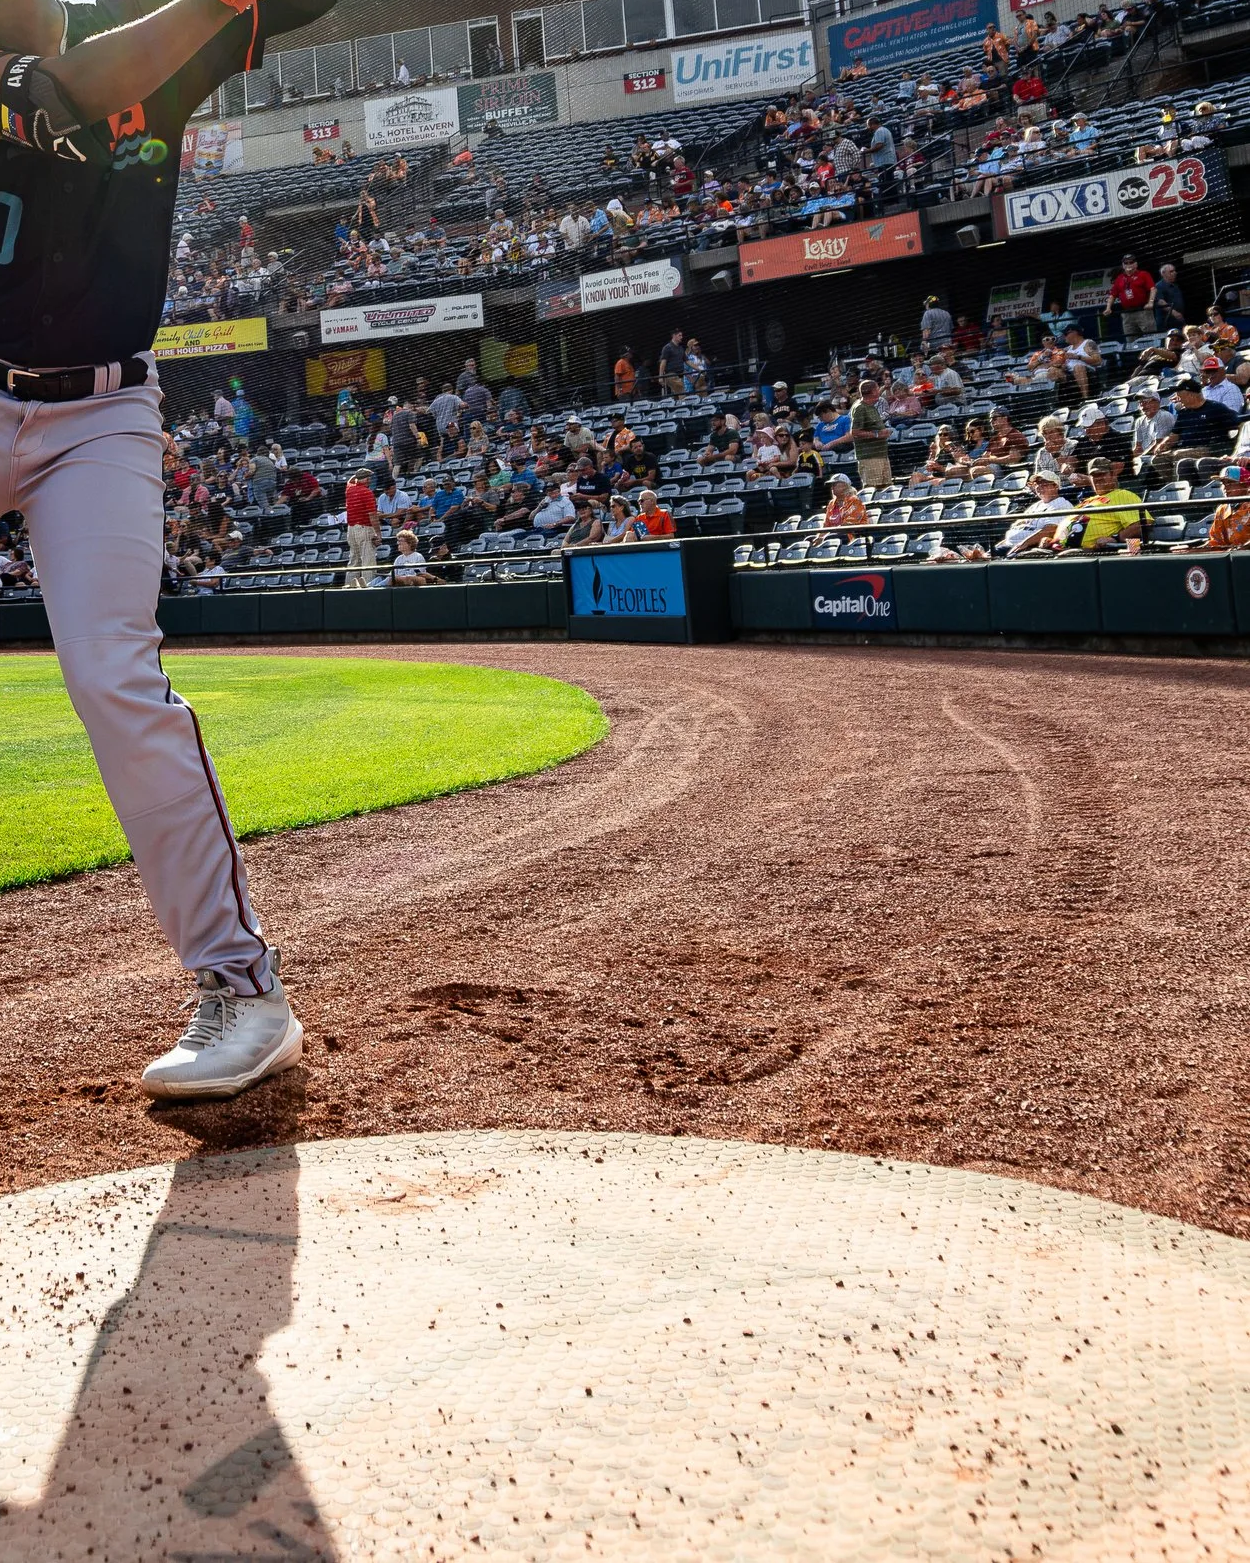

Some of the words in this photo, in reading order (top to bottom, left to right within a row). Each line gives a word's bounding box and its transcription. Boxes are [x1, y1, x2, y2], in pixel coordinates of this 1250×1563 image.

[930, 17, 978, 35] TECHNOLOGIES
[676, 40, 812, 85] UniFirst
[628, 69, 660, 80] SECTION
[633, 79, 657, 91] 312
[677, 86, 715, 98] UNIFORMS
[725, 80, 759, 91] SERVICES
[769, 72, 812, 84] SOLUTIONS
[485, 105, 530, 121] BUFFET
[308, 119, 335, 129] SECTION
[368, 131, 385, 140] U.S.
[387, 127, 417, 137] HOTEL
[418, 121, 455, 134] TAVERN
[311, 127, 332, 140] 313
[374, 132, 438, 146] HOLLIDAYSBURG,
[439, 130, 450, 138] PA
[1011, 185, 1083, 229] FOX
[1084, 183, 1106, 214] 8
[1117, 182, 1150, 202] abc
[1148, 157, 1209, 209] 23
[803, 236, 849, 260] Levity
[584, 280, 603, 289] Avoid
[603, 272, 643, 286] Outrageous
[643, 269, 660, 279] Fees
[585, 288, 608, 304] KNOW
[608, 285, 630, 301] YOUR
[451, 303, 478, 312] POLARIS
[993, 304, 1013, 314] BEST
[1013, 301, 1036, 310] SEATS
[1079, 298, 1096, 307] THE
[332, 324, 359, 335] YAMAHA
[371, 319, 397, 328] CYCLE
[397, 316, 429, 325] CENTER
[204, 329, 211, 337] &
[212, 325, 235, 340] Grill
[157, 349, 175, 357] FIRE
[176, 346, 204, 355] HOUSE
[205, 344, 229, 353] PIZZA
[184, 339, 201, 347] AND
[608, 584, 667, 614] PEOPLES
